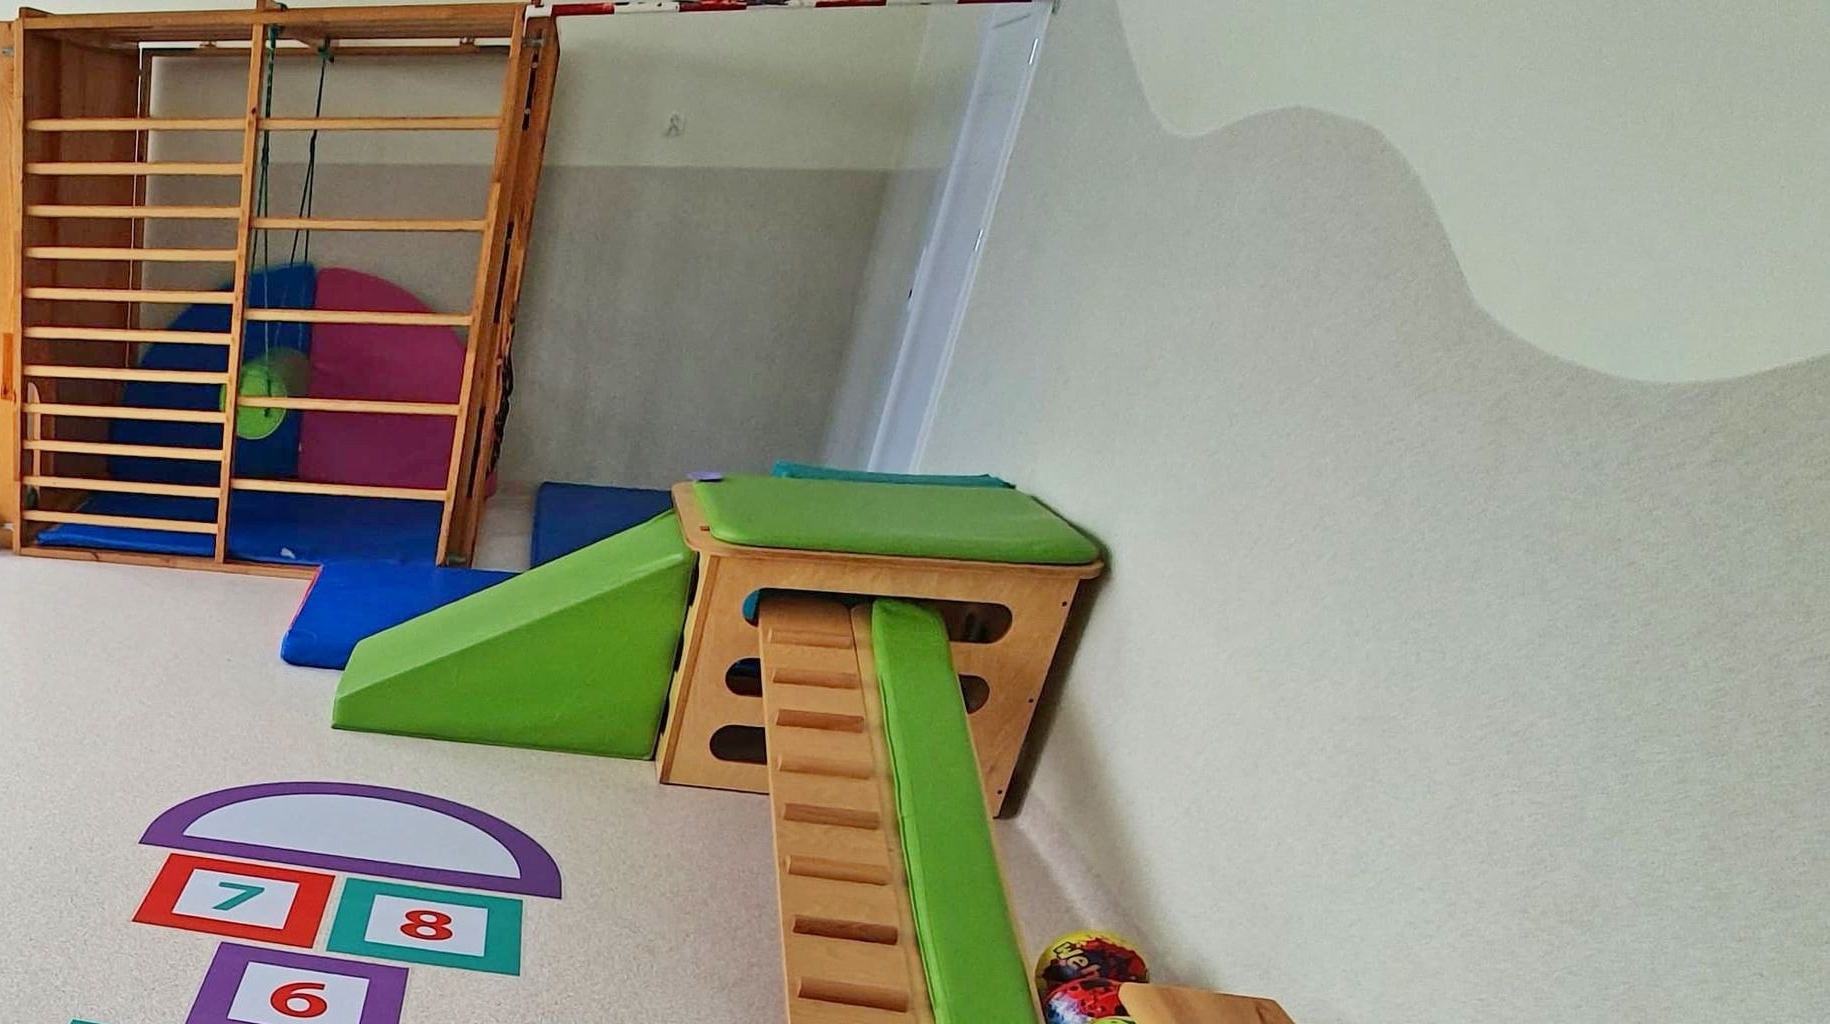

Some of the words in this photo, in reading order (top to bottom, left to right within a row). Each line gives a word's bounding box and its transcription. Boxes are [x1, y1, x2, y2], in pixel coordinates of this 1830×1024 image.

[214, 881, 265, 911] 7
[400, 910, 453, 941] 8
[270, 982, 328, 1018] 6
